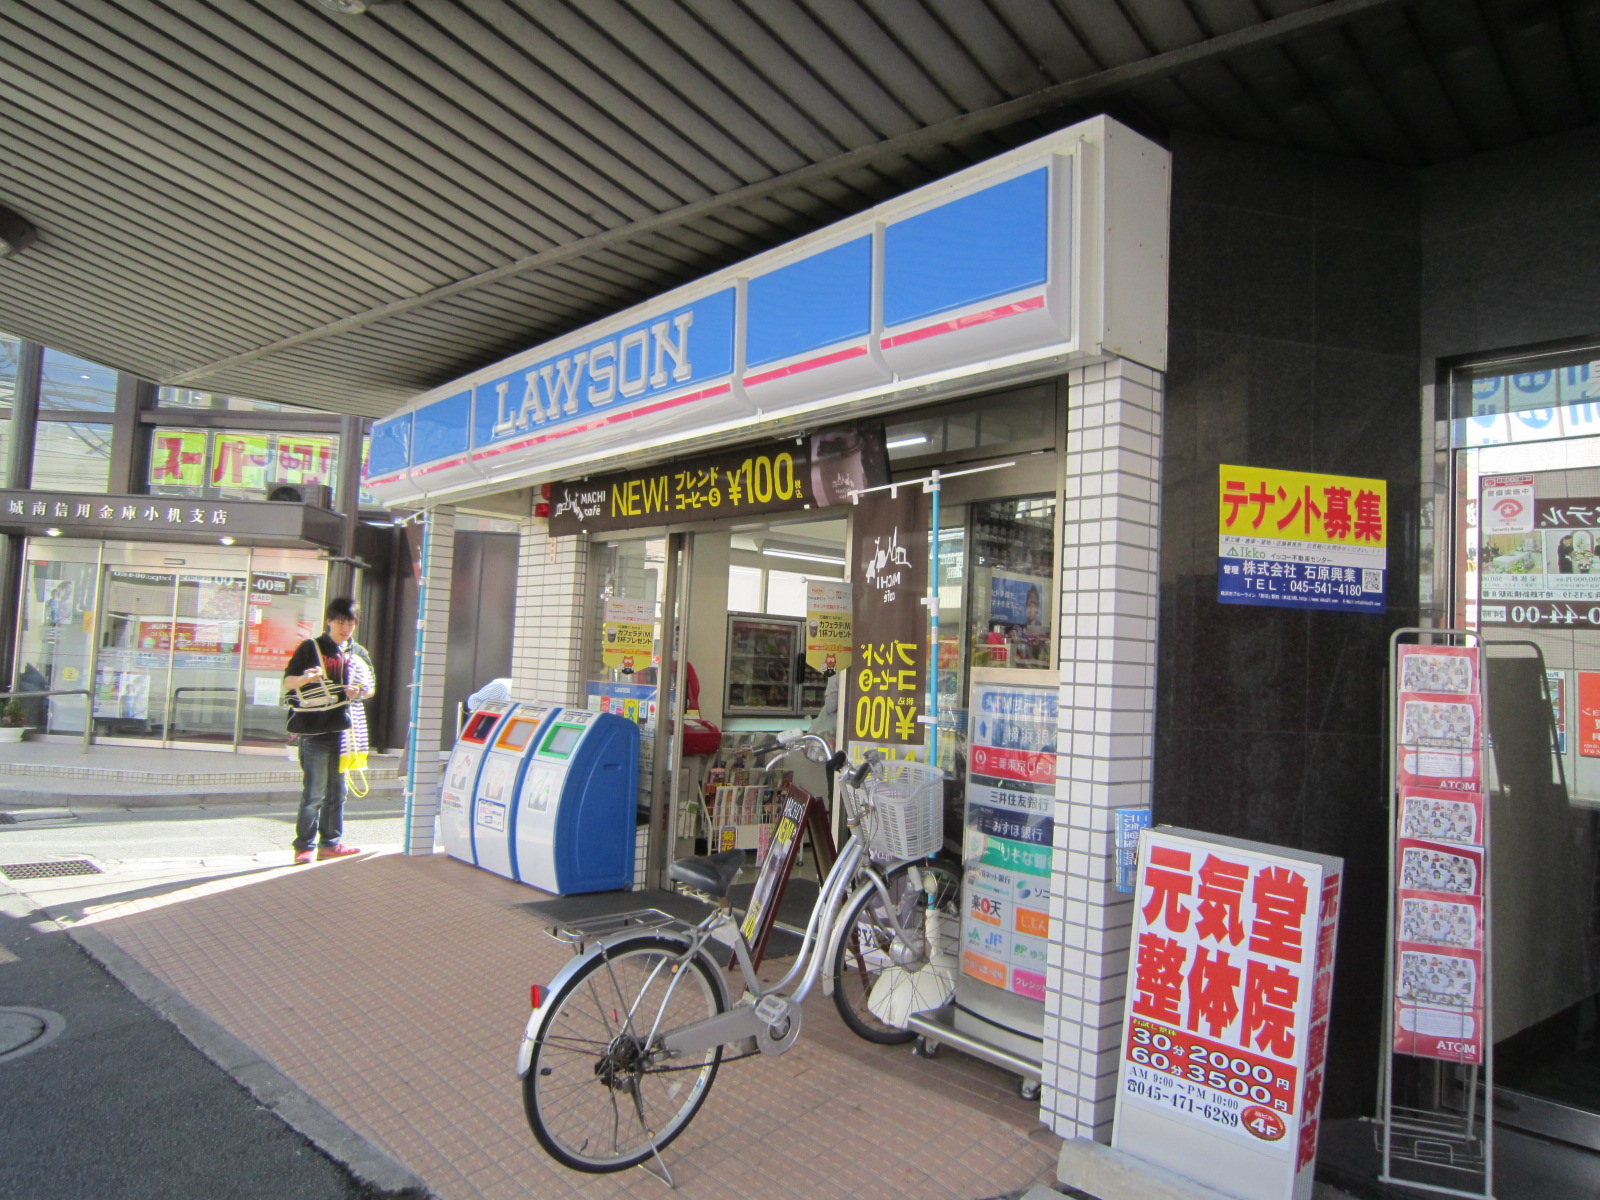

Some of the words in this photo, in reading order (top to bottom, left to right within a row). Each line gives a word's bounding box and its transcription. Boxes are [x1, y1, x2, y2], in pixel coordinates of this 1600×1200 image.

[494, 311, 694, 436] LAWSON
[675, 466, 719, 491] ブレンド
[728, 452, 794, 506] ¥100
[581, 490, 606, 504] MACHI
[611, 475, 669, 517] NEW!
[9, 499, 228, 525] 城南信用金庫小机支店
[584, 505, 601, 517] café
[1223, 480, 1382, 542] テナント募集
[1240, 547, 1266, 559] Ikko
[1271, 553, 1332, 564] イッコー不動産センター
[1223, 564, 1239, 575] 管理
[1243, 560, 1297, 578] 株式会社
[1304, 565, 1356, 583] 石原興業
[1290, 580, 1362, 597] 045-541-4180
[617, 637, 652, 645] 1杯プレゼント
[819, 630, 852, 639] 1杯プレゼント
[990, 755, 1055, 777] 三菱東京UFJ
[1440, 780, 1477, 791] ATOM
[990, 790, 1049, 811] 三井住友銀行
[992, 820, 1043, 842] みずほ銀行
[1001, 845, 1051, 869] りそな銀
[1142, 845, 1309, 964] 元気堂
[1030, 949, 1047, 961] ゆう
[1132, 932, 1299, 1059] 整体院
[1436, 1040, 1477, 1055] ATOM
[1132, 1027, 1185, 1057] 30分
[1188, 1045, 1290, 1091] 2000円
[1129, 1066, 1148, 1081] AM
[1153, 1073, 1174, 1089] 9:00
[1187, 1084, 1207, 1100] PM
[1212, 1093, 1239, 1111] 10:00
[1131, 1046, 1184, 1077] 60分
[1186, 1064, 1288, 1112] 3500円
[1137, 1081, 1239, 1127] 045-471-6289
[1250, 1117, 1279, 1136] 4F
